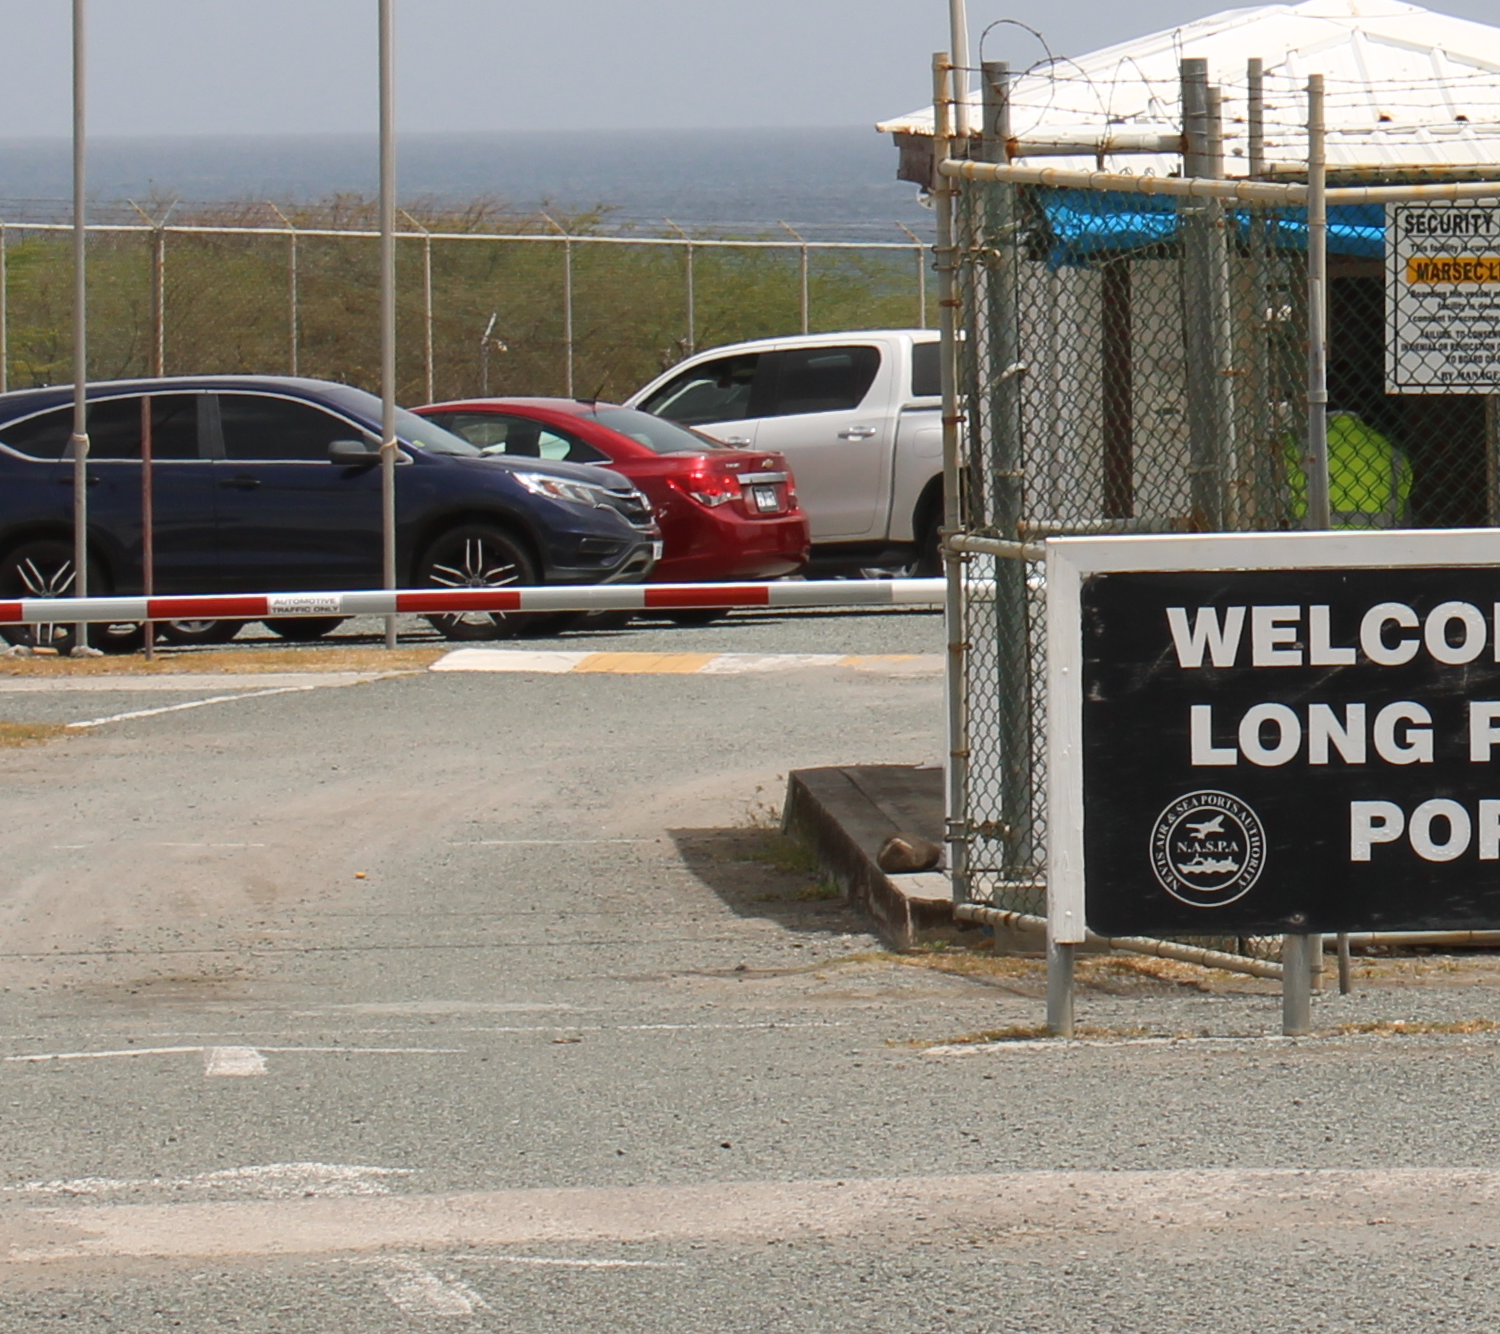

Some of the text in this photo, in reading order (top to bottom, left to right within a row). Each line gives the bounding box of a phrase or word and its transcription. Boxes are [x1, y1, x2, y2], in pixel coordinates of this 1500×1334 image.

[1405, 214, 1493, 233] SECURITY
[1417, 263, 1484, 280] MARSEC
[1190, 701, 1434, 766] LONG
[1156, 795, 1261, 891] NEVIS AIR & SEA PORTS AUTHORITY
[1177, 841, 1239, 853] N.A.S.P.A
